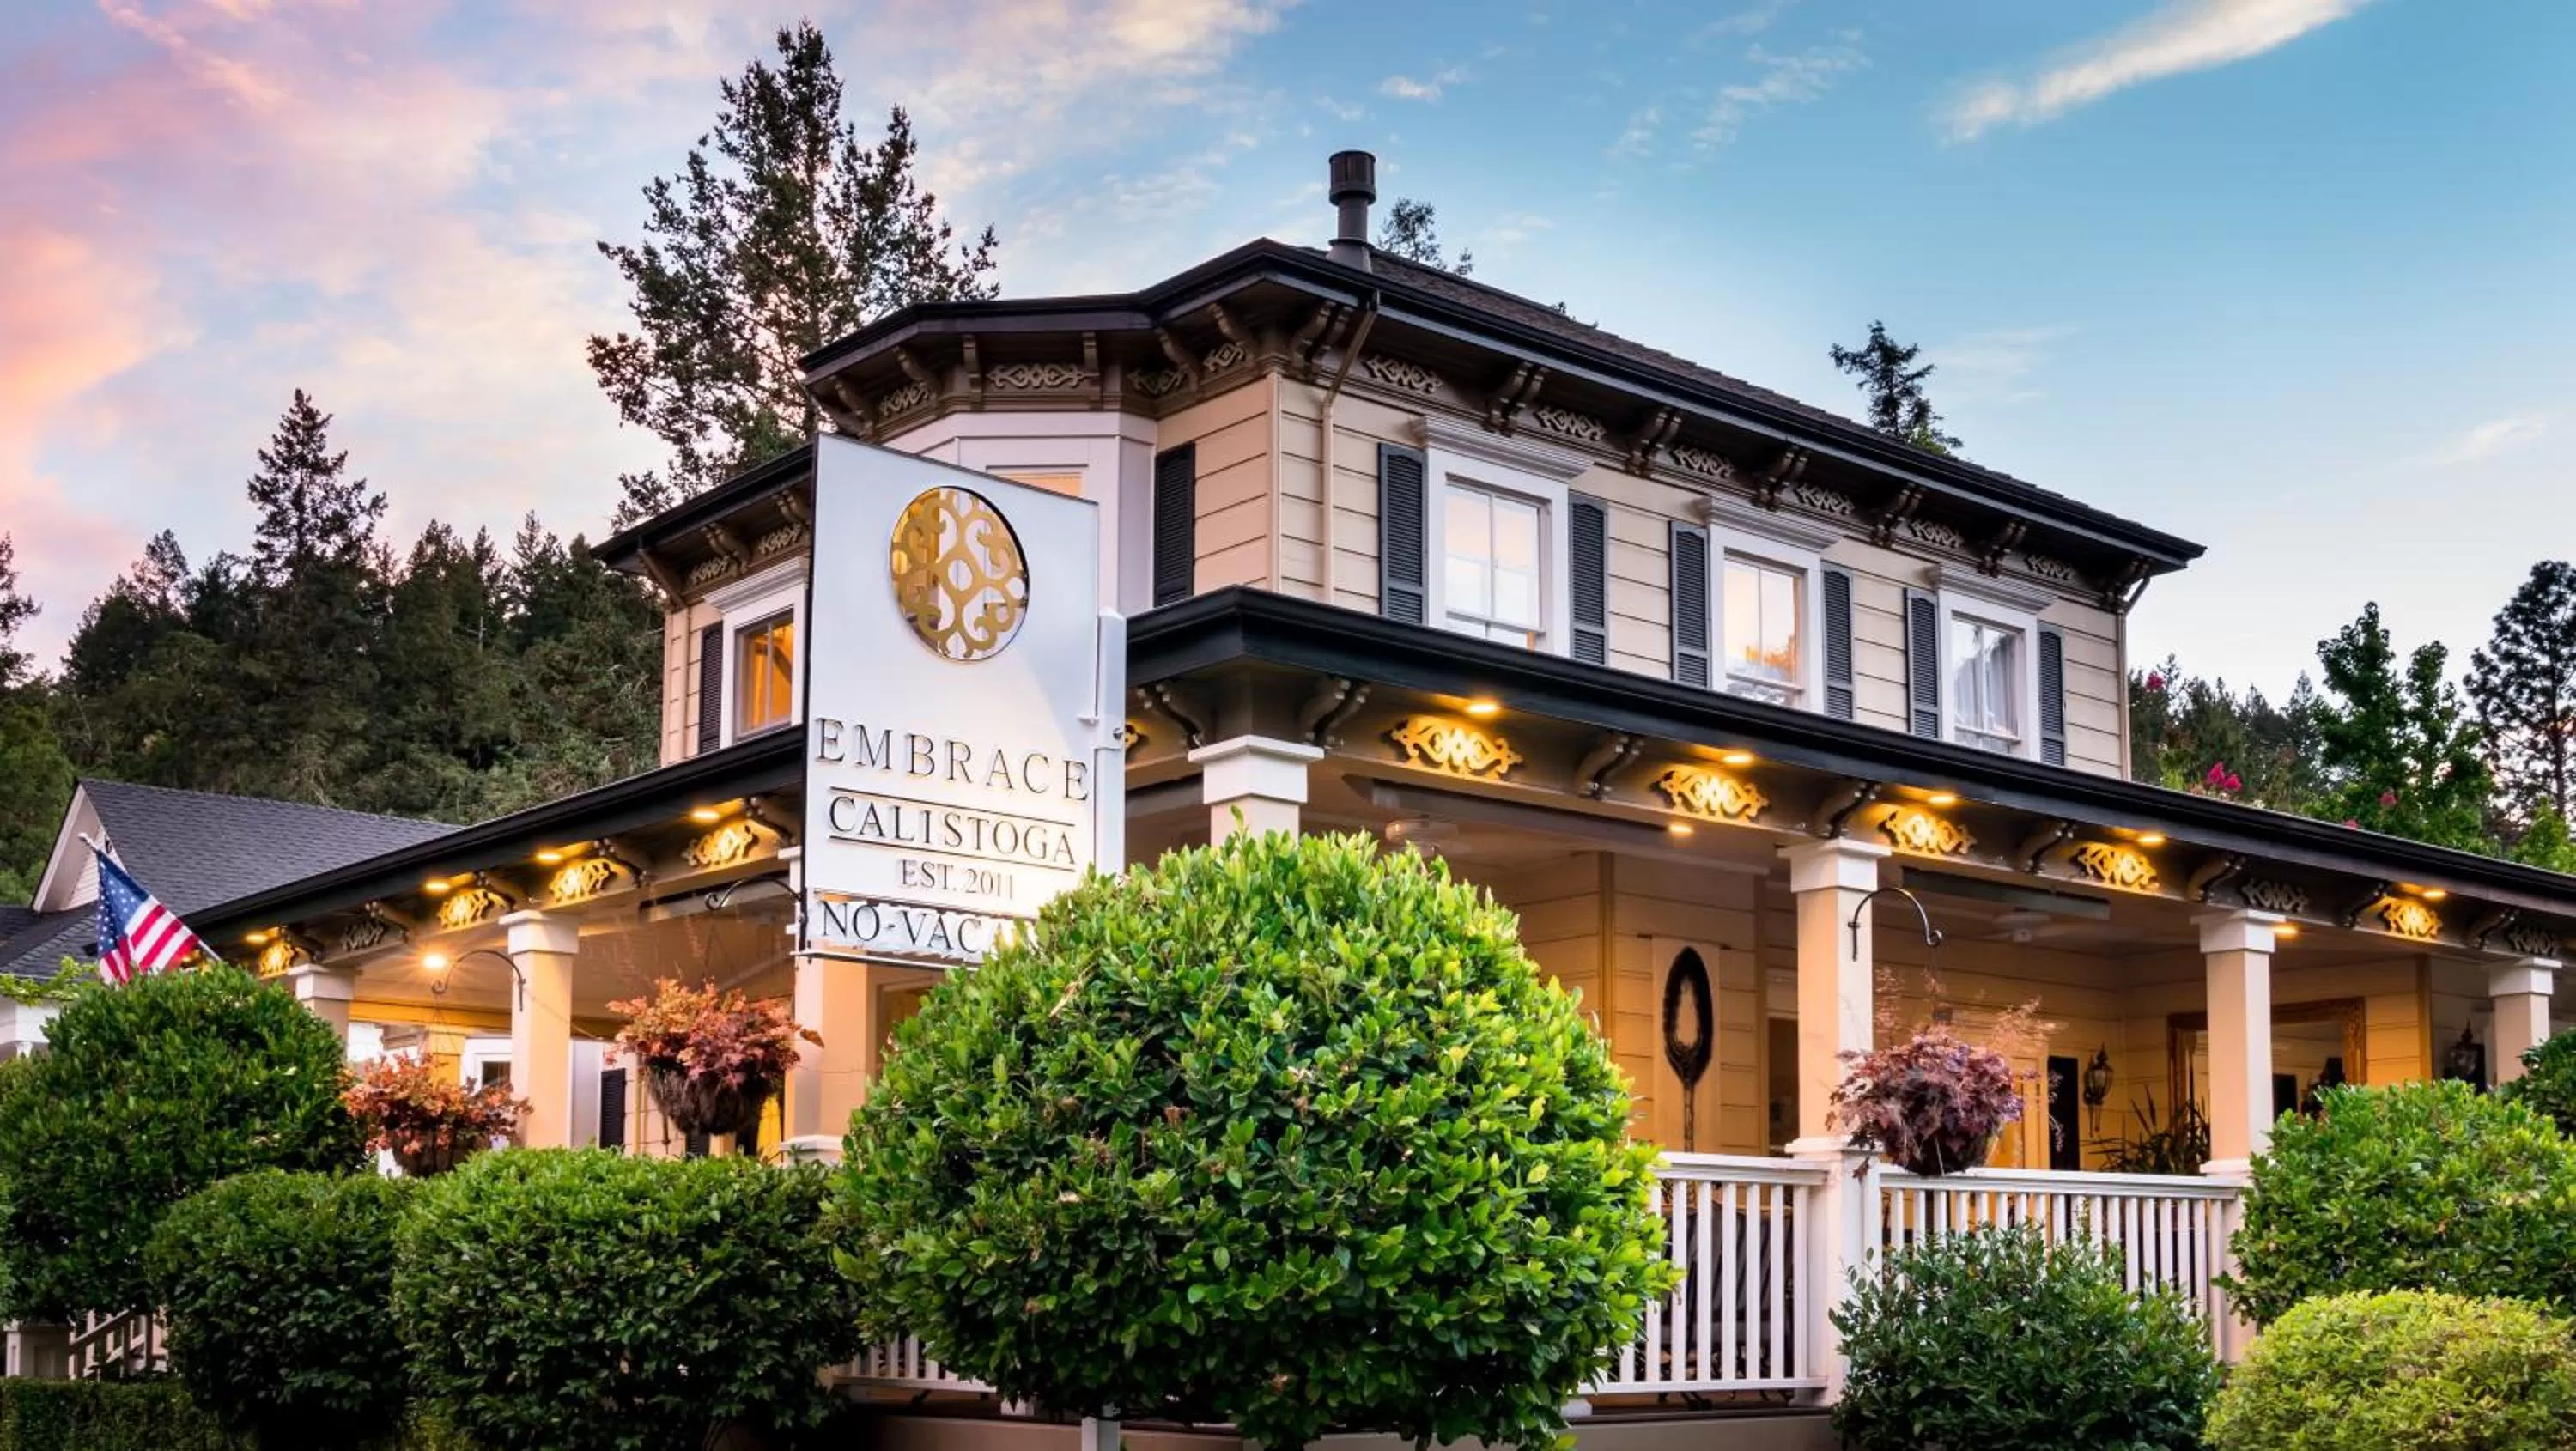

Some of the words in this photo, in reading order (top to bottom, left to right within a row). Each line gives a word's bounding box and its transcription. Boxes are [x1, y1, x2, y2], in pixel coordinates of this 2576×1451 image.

[816, 716, 1089, 802] EMBRACE
[829, 795, 1076, 865] CALISTOGA
[901, 859, 957, 891] EST.
[965, 868, 1013, 900] 2011
[822, 901, 1006, 954] NO-VAC
